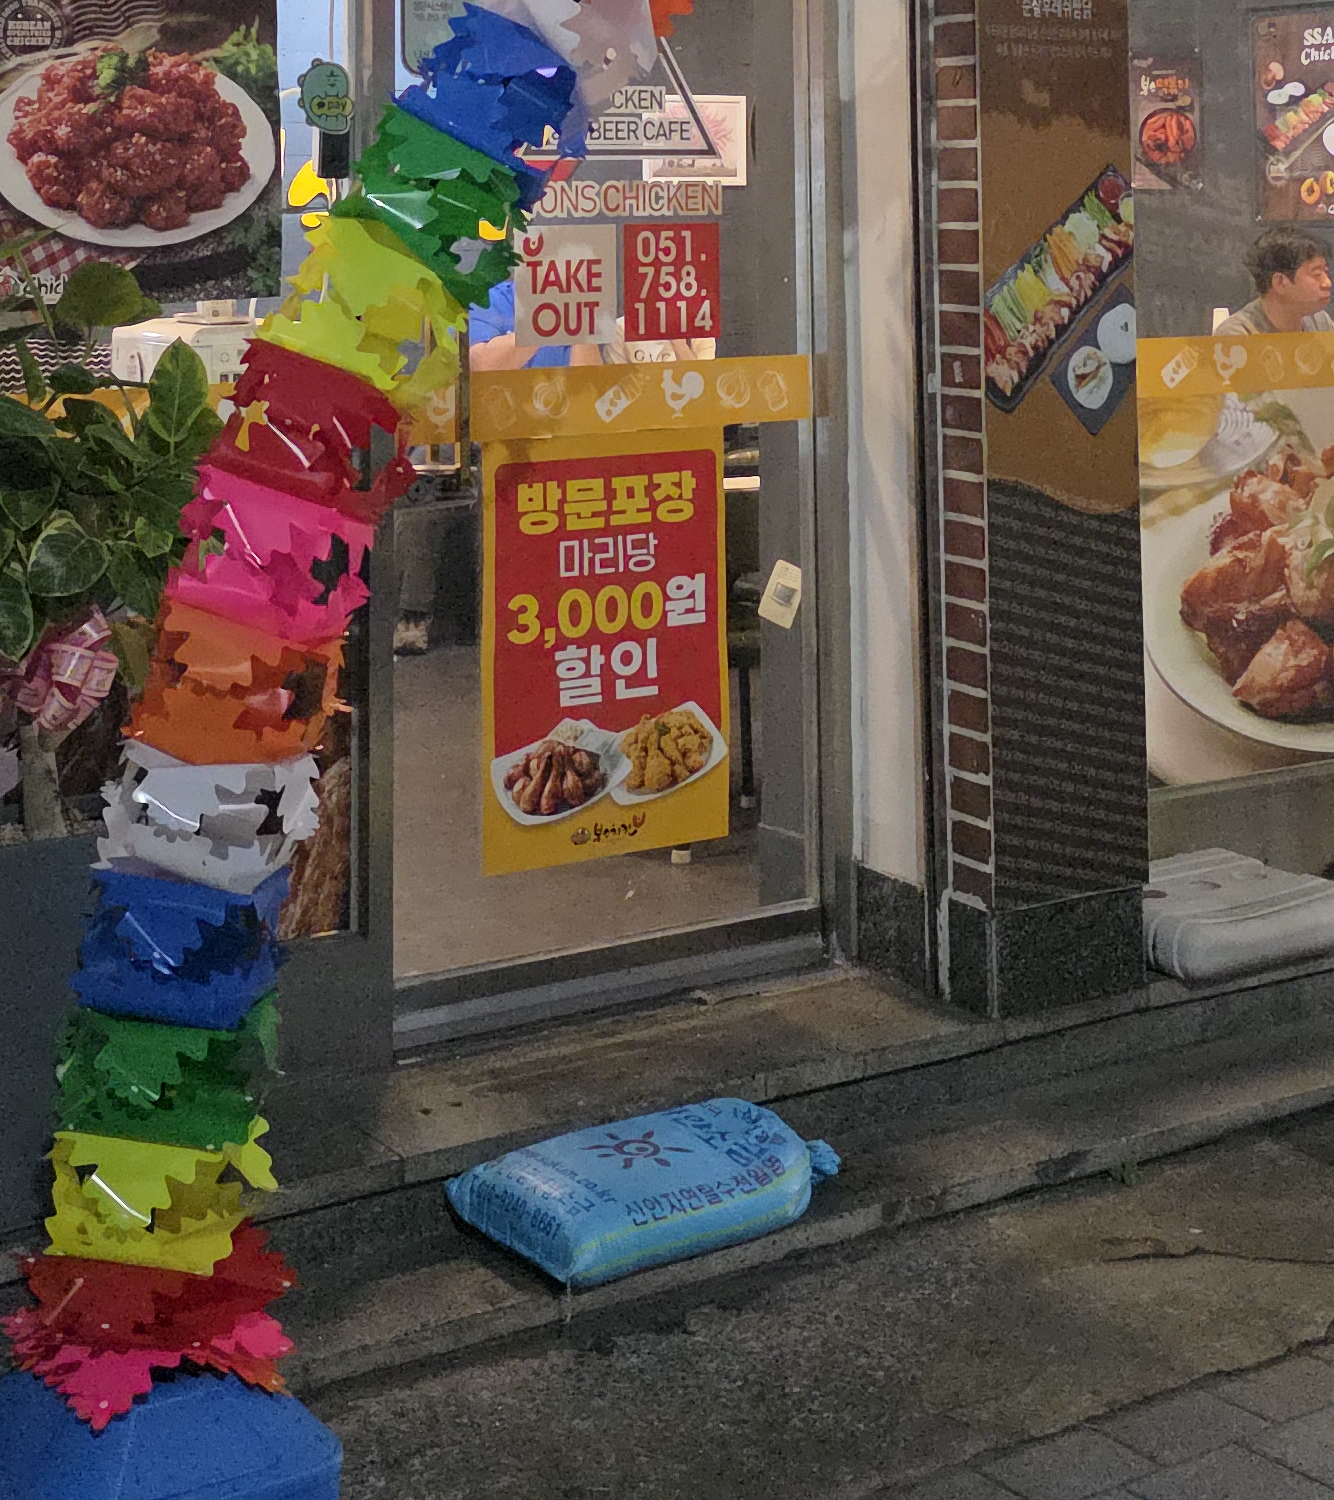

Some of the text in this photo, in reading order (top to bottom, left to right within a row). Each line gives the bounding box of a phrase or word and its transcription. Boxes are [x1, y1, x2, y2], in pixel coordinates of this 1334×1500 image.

[325, 99, 349, 113] pay
[643, 120, 691, 141] CAFE
[540, 182, 720, 214] ONS CHICKEN
[636, 230, 708, 263] 051.
[527, 259, 603, 295] TAKE
[637, 266, 708, 299] 758.
[532, 302, 600, 338] OUT
[636, 300, 714, 335] 1114
[516, 470, 696, 536] 방문포장
[558, 532, 658, 579] 마리당
[506, 573, 707, 649] 3,000원
[553, 638, 659, 708] 할인
